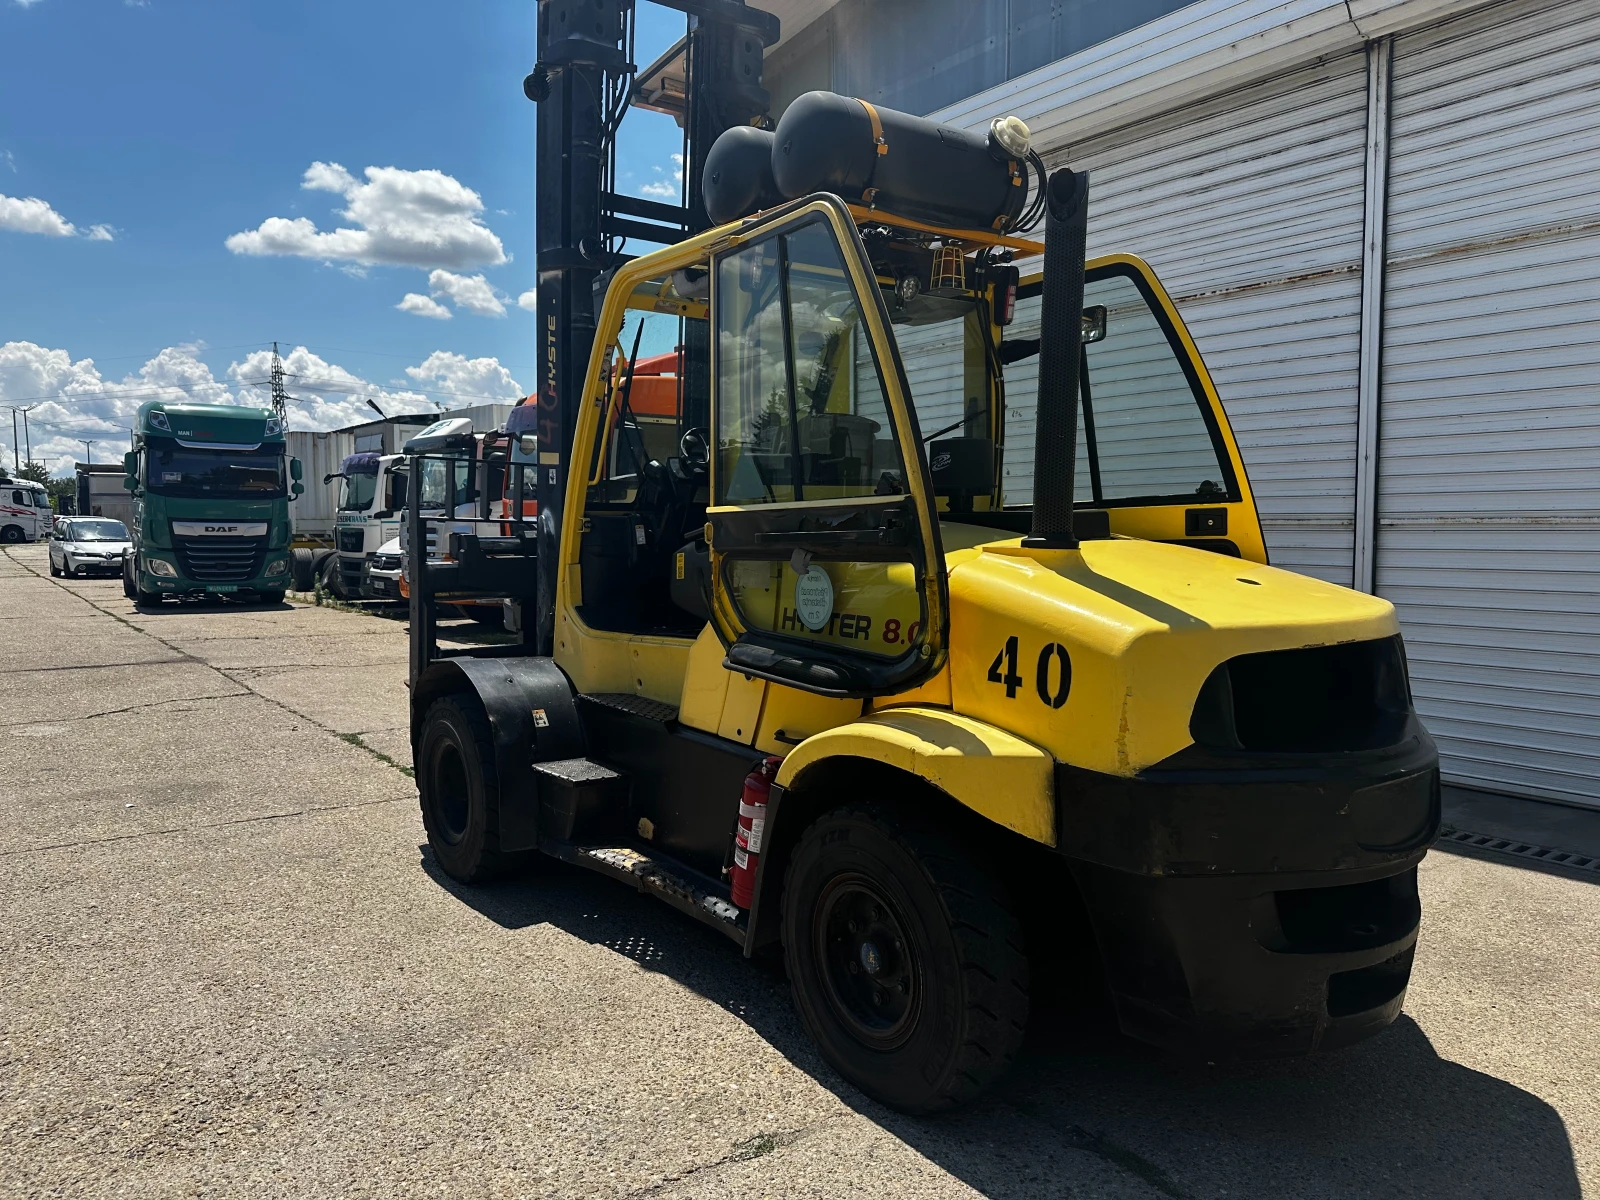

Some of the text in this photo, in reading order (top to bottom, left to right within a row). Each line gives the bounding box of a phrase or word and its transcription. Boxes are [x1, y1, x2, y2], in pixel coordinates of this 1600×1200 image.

[547, 298, 556, 396] HYSTE
[782, 607, 872, 640] HYTER
[987, 635, 1072, 709] 40
